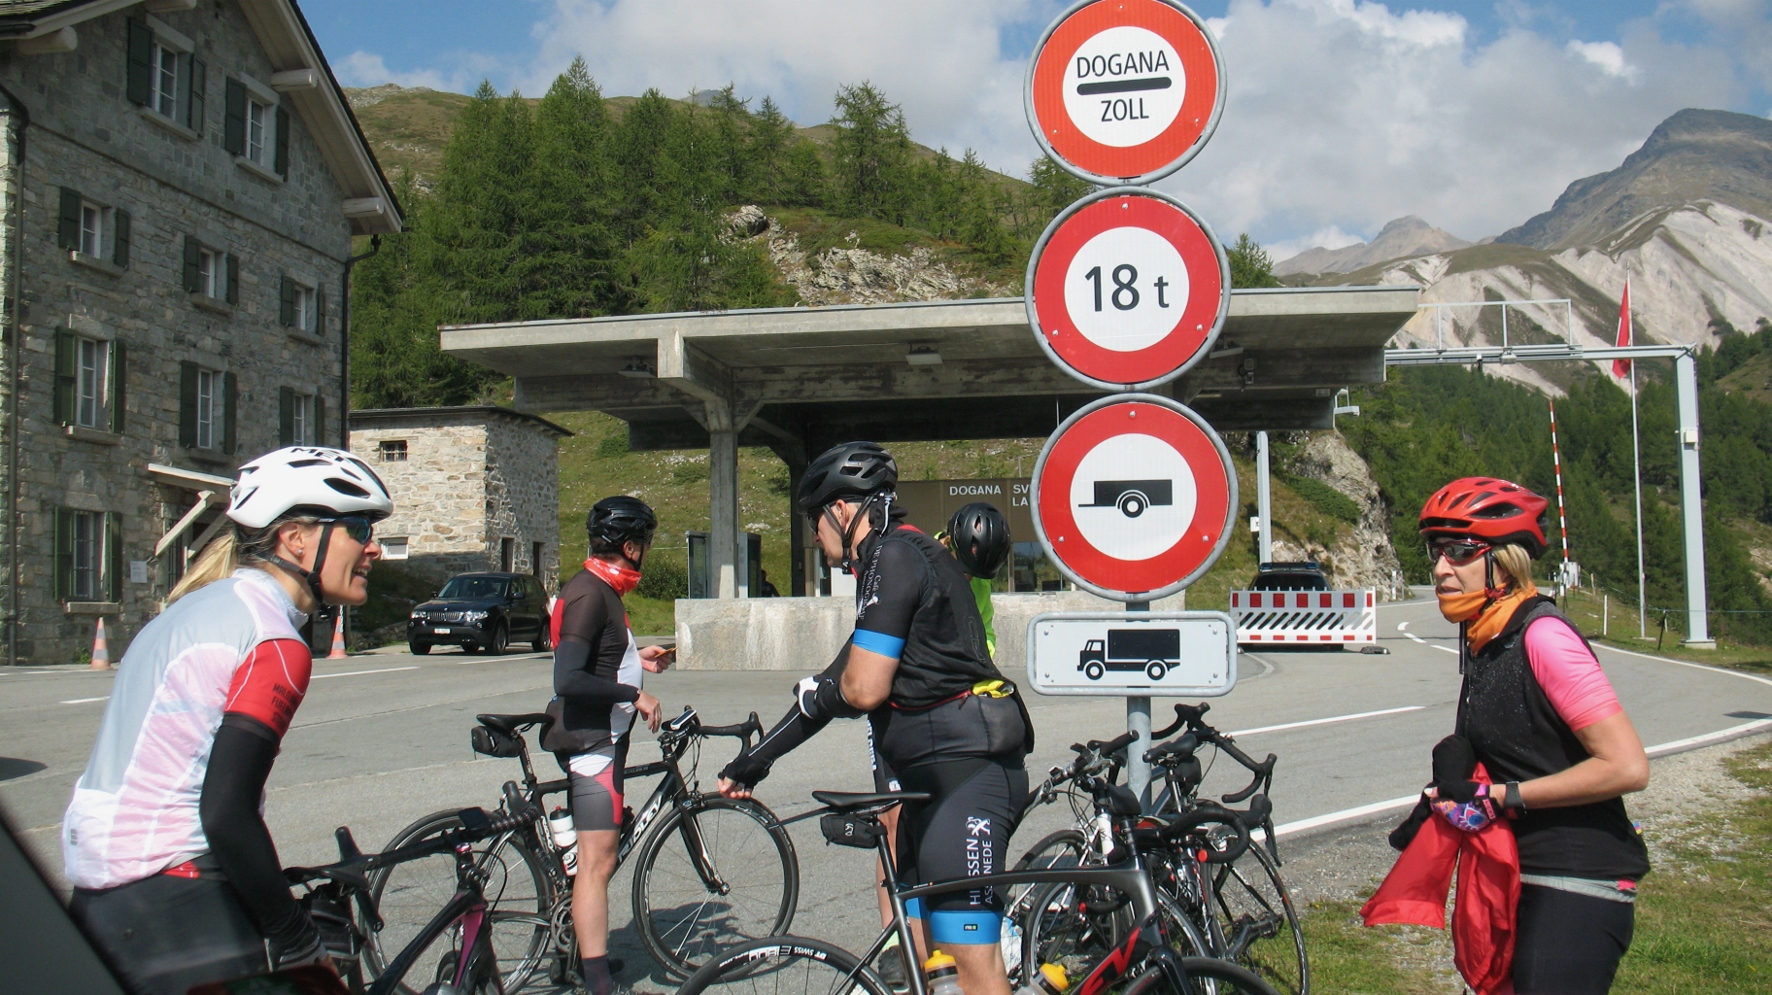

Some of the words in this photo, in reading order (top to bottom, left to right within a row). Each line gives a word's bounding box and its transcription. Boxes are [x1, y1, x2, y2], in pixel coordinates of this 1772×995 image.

[1076, 50, 1170, 78] DOGANA
[1100, 98, 1149, 122] ZOLL
[1085, 263, 1140, 312] 18
[1153, 275, 1170, 309] t
[949, 485, 1002, 496] DOGANA
[1013, 484, 1031, 494] SV
[793, 946, 815, 956] SWISS
